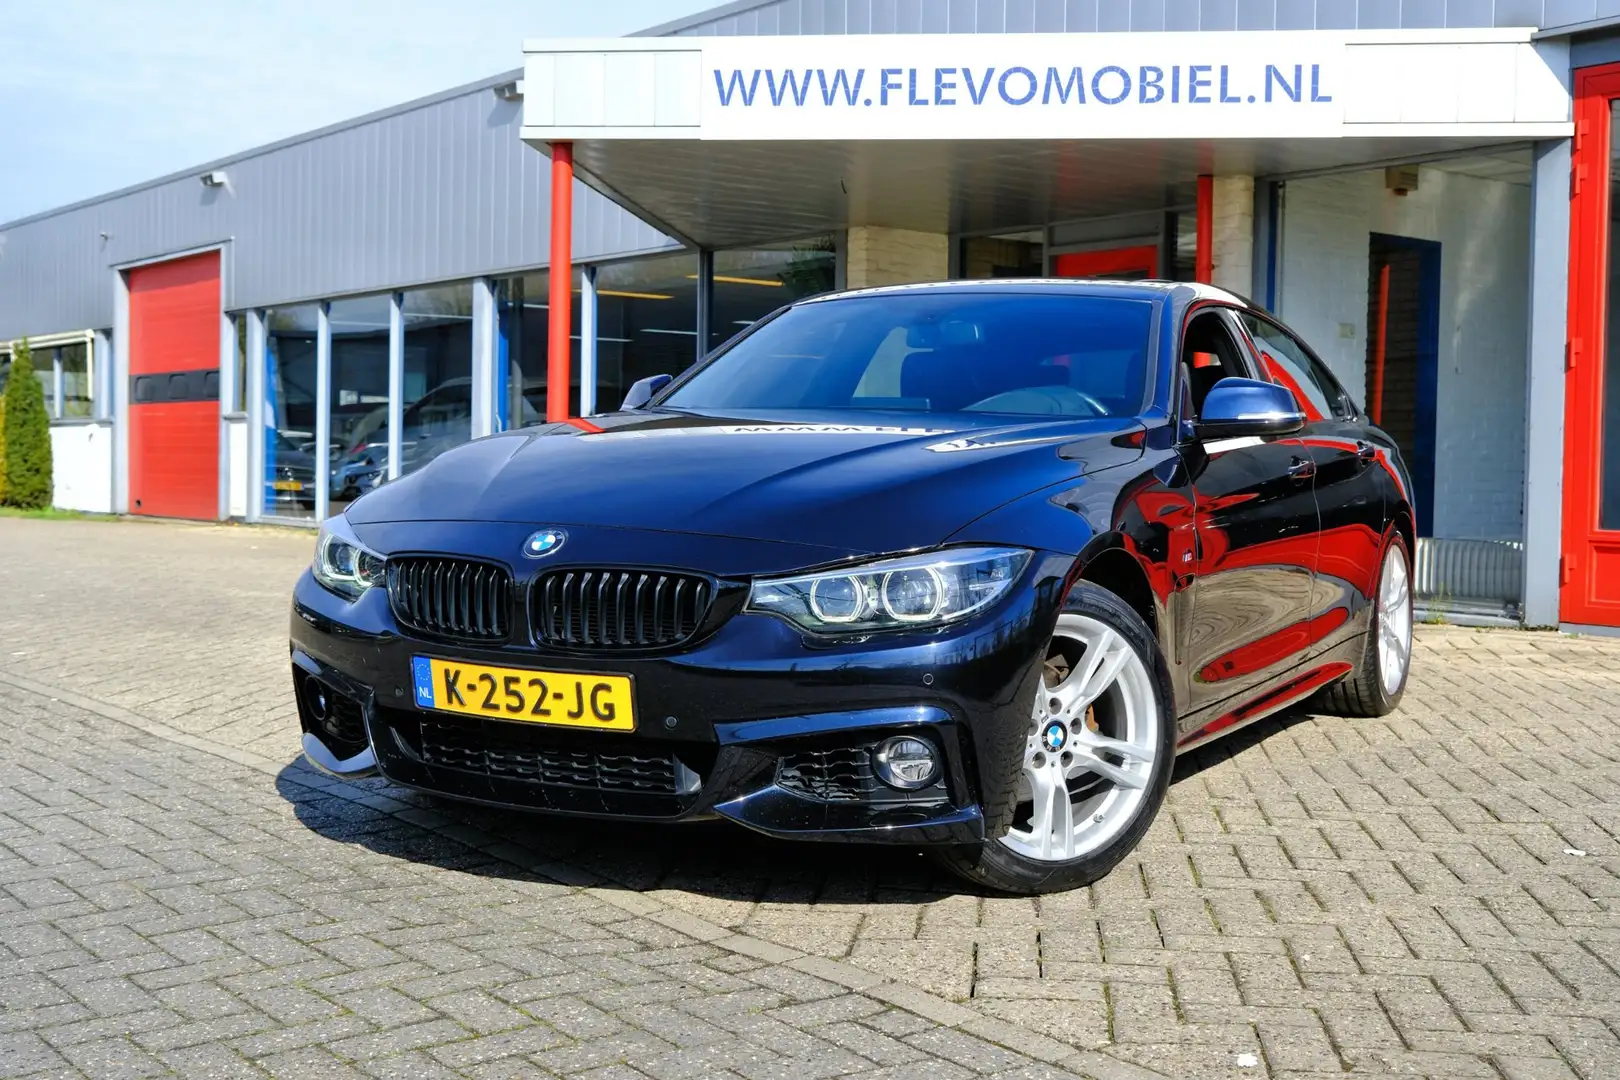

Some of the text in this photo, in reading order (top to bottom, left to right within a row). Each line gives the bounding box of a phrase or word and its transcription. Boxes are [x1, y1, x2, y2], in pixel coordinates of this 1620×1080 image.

[713, 63, 1333, 106] WWW.FLEVOMOBIEL.NL
[418, 686, 432, 699] NL
[444, 668, 615, 721] K-252-JG
